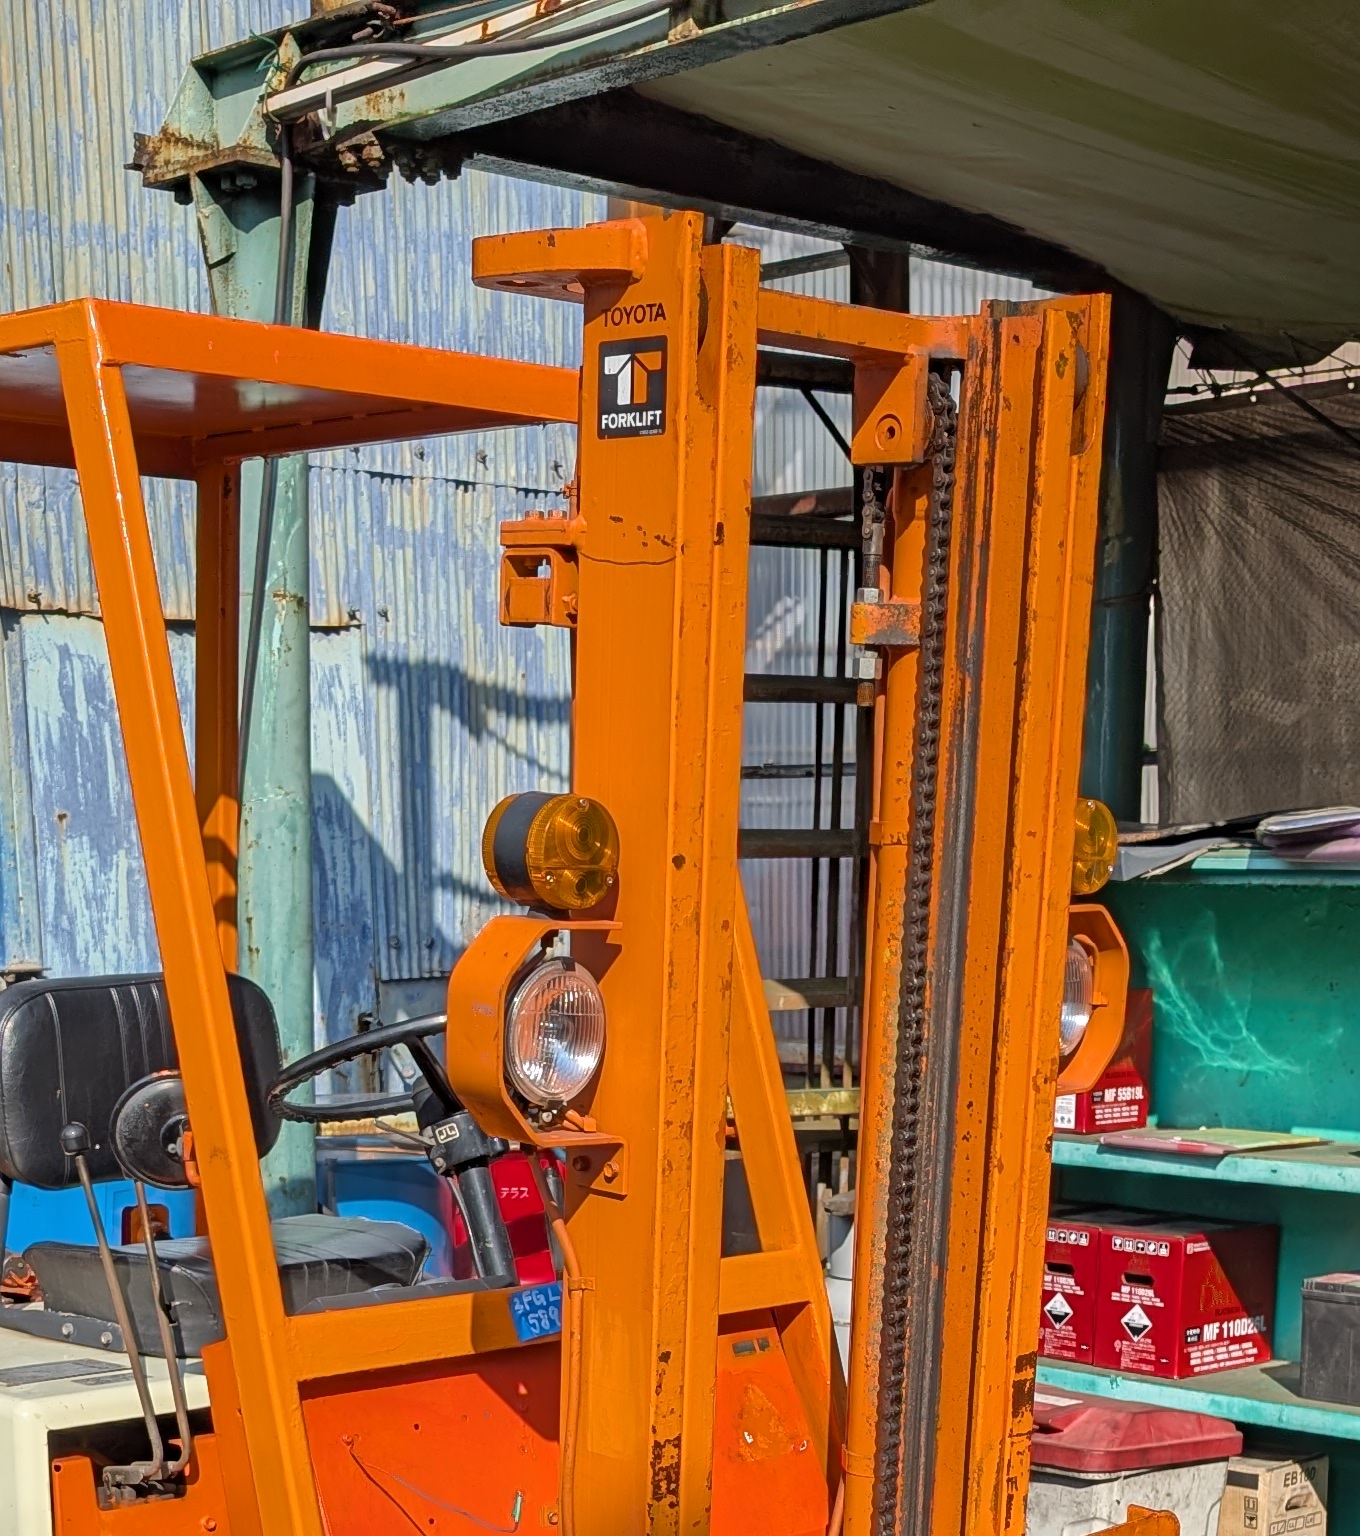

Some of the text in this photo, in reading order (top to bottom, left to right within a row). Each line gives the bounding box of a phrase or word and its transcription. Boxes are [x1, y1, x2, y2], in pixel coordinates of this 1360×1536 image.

[601, 303, 666, 328] TOYOTA
[601, 410, 662, 430] FORKLIFT
[1104, 1089, 1117, 1102] MF
[500, 1187, 529, 1199] テラス
[1203, 1322, 1220, 1342] MF
